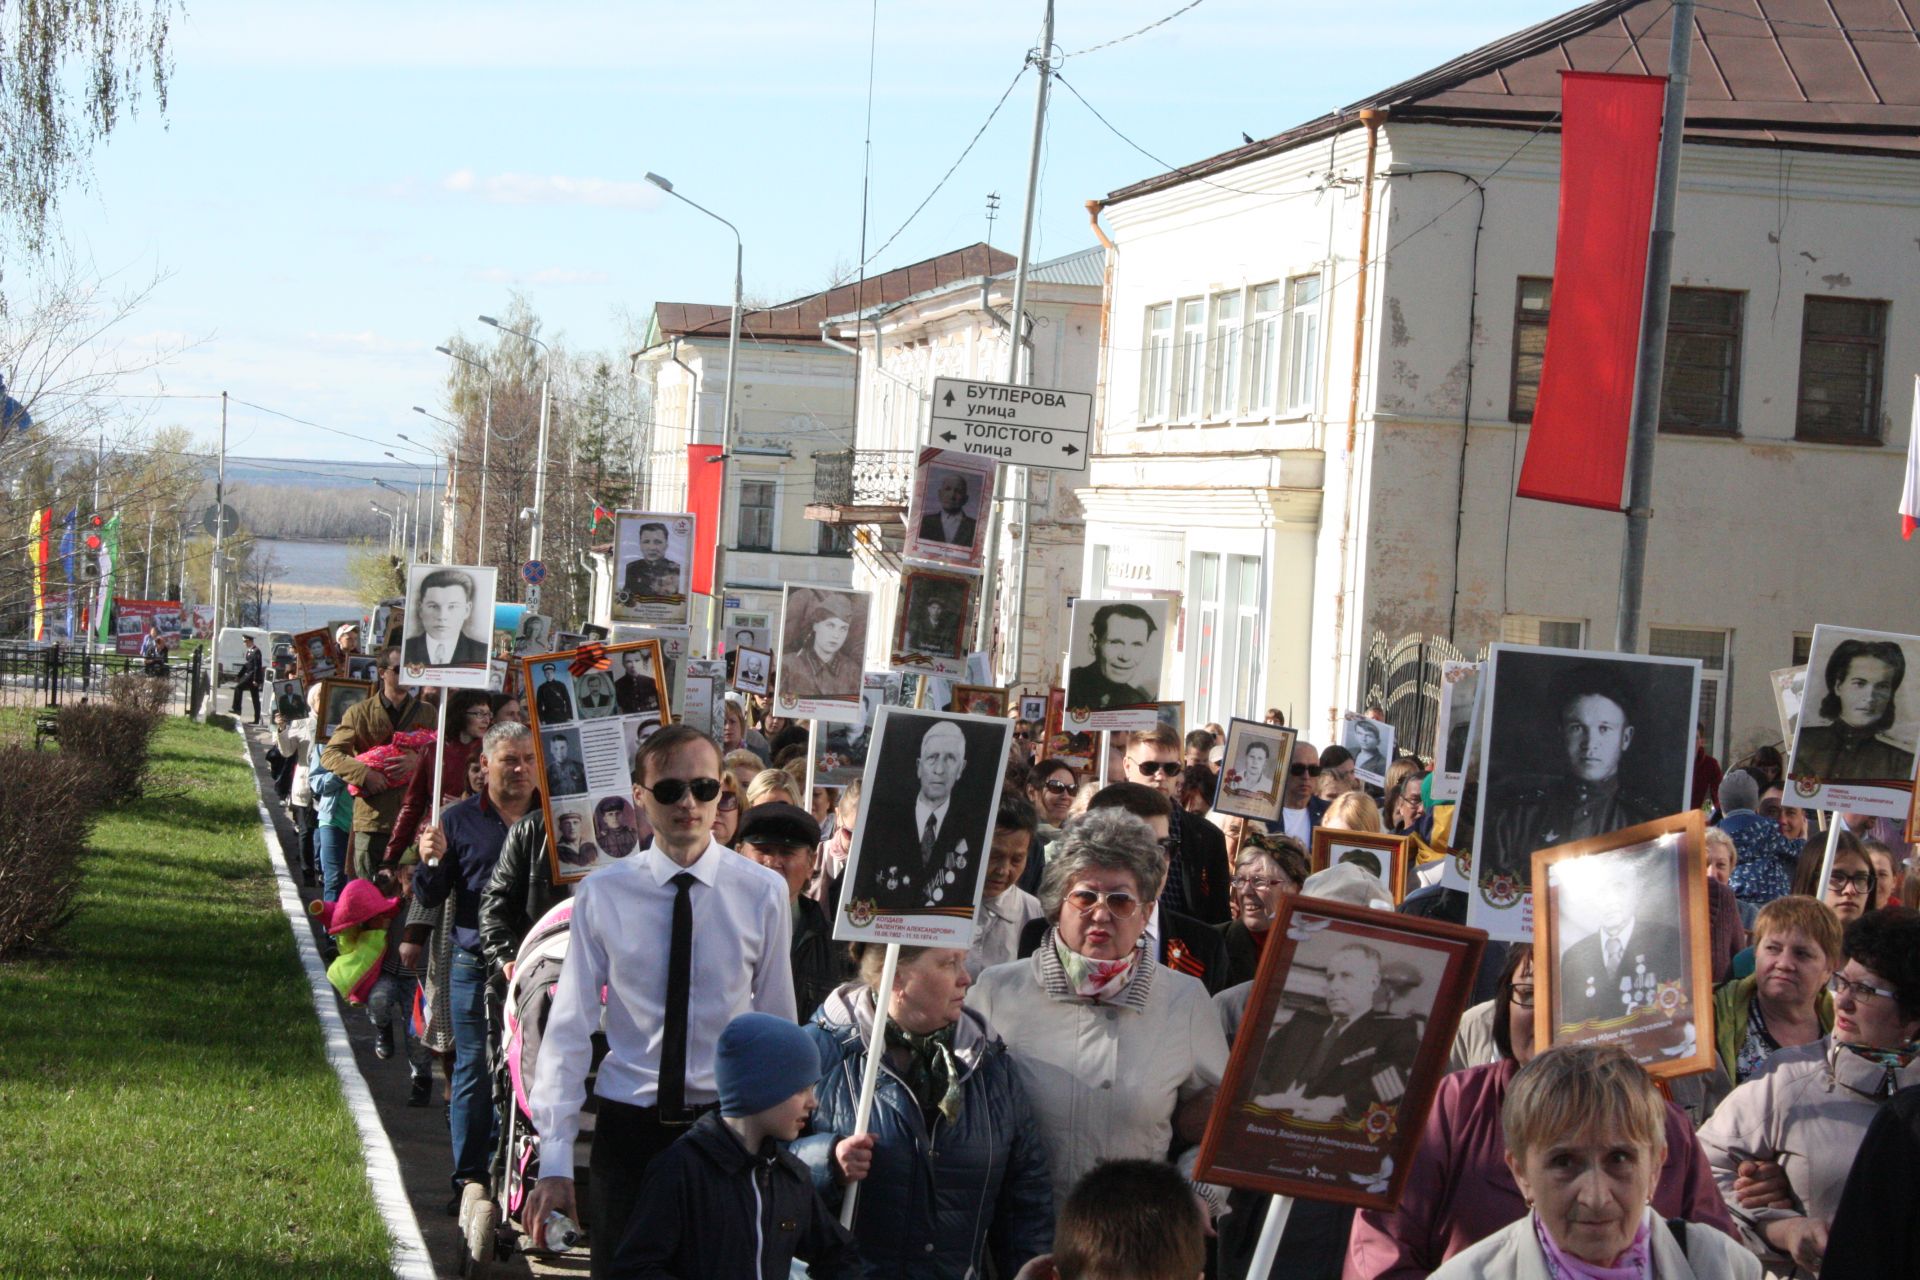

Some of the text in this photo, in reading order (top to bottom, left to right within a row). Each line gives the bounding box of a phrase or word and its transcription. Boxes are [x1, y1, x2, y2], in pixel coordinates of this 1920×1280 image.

[966, 385, 1066, 408] БУТЛЕРОВА
[966, 403, 1016, 419] улица
[964, 423, 1053, 445] ТОЛСТОГО
[964, 442, 1012, 457] улица
[875, 923, 905, 931] ВАЛЕНТИН
